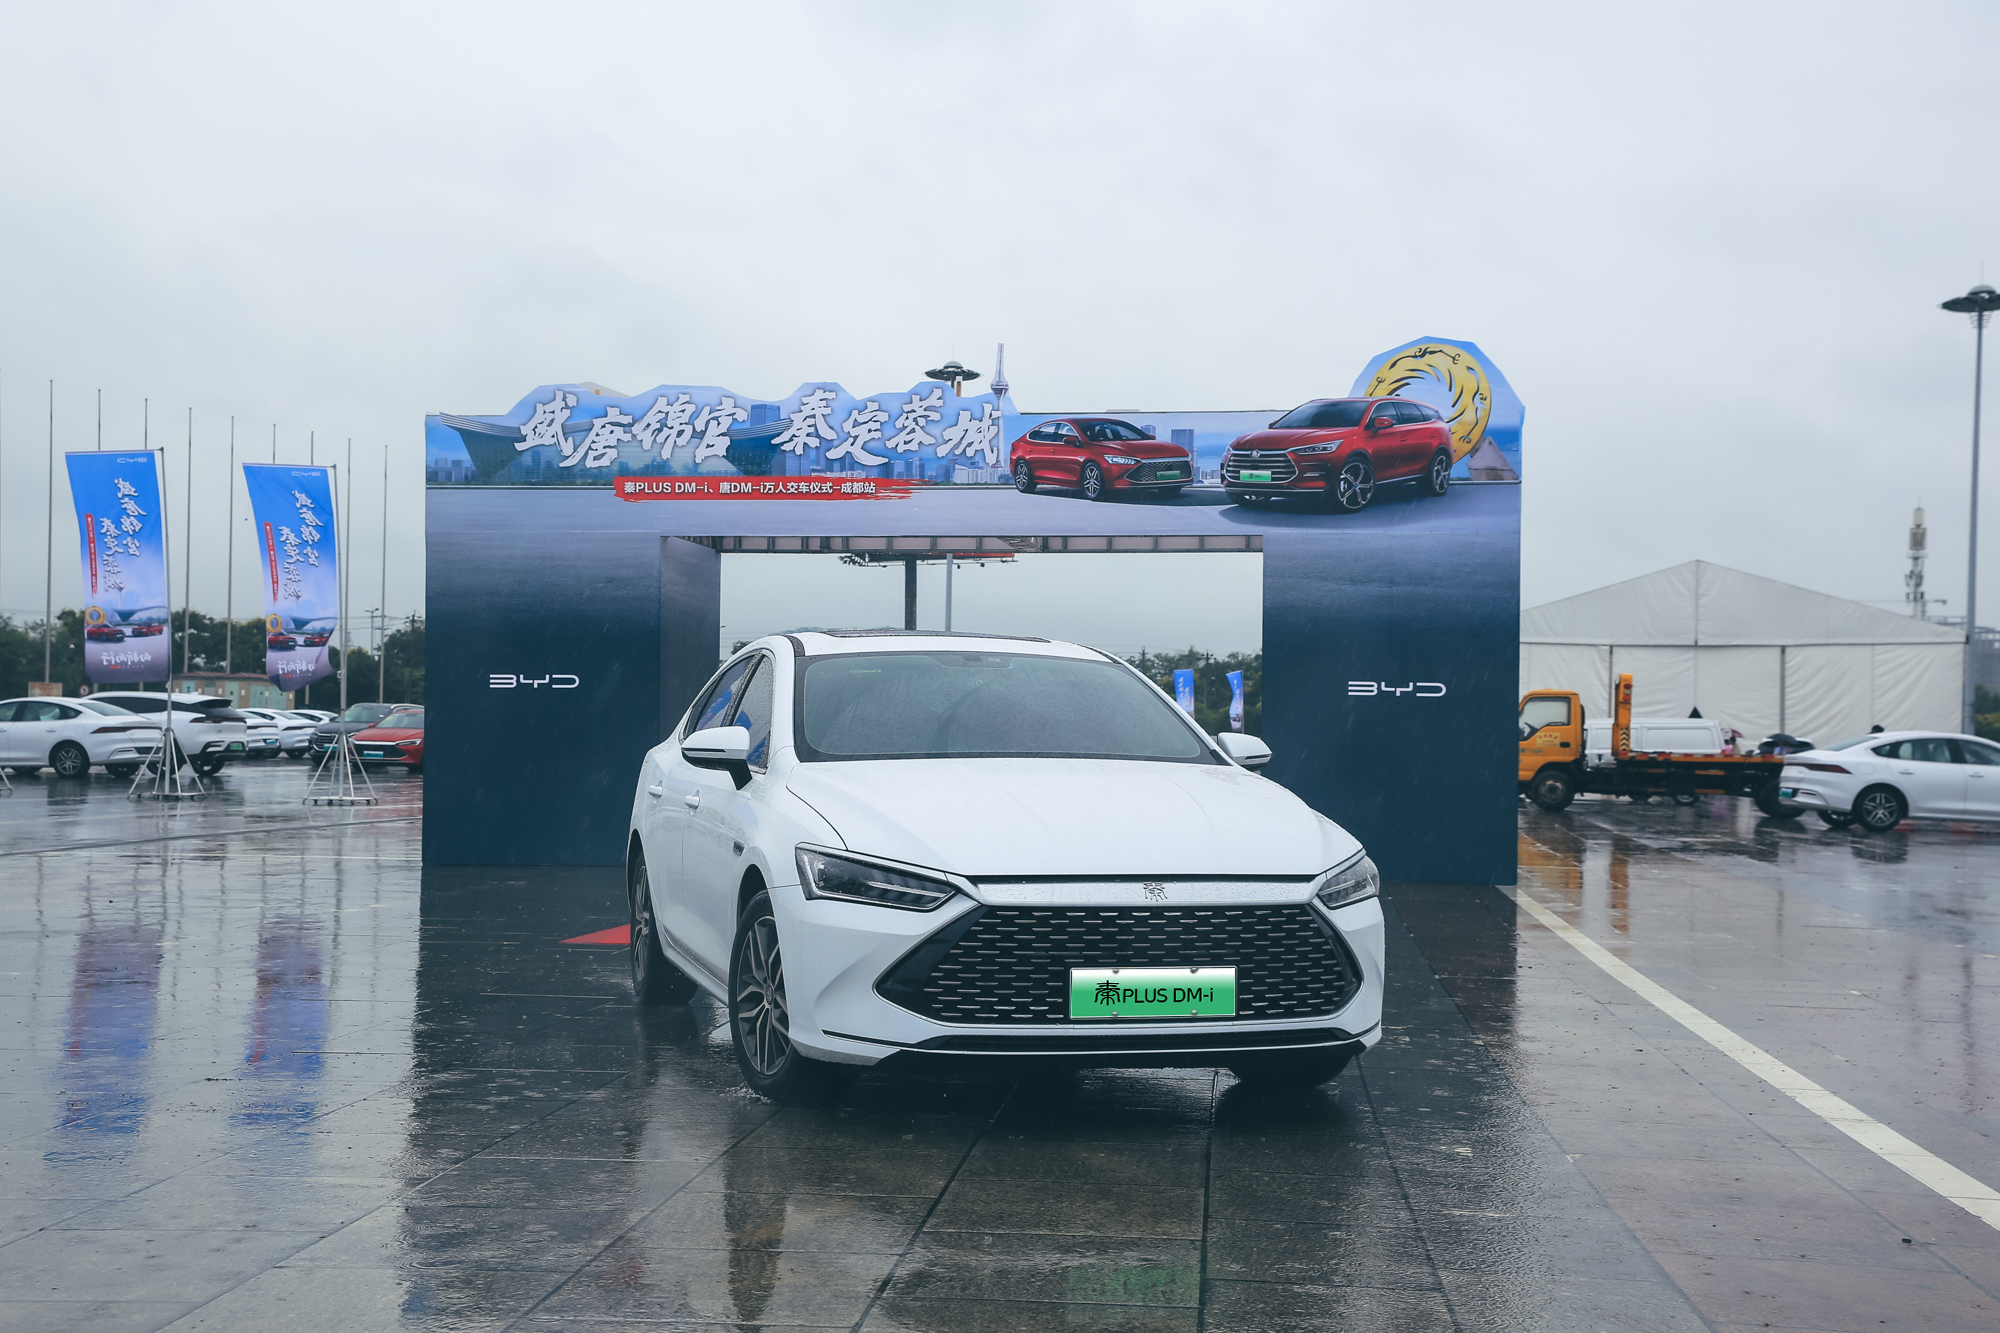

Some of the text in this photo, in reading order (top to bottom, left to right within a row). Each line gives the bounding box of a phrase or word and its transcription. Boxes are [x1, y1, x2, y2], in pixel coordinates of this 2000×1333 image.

[514, 387, 1003, 469] 盛唐锦官 秦定蓉城
[624, 482, 671, 494] 秦PLUS
[489, 674, 580, 688] BYD
[1348, 681, 1446, 697] BYD
[1094, 980, 1214, 1005] 秦PLUS DM-i
